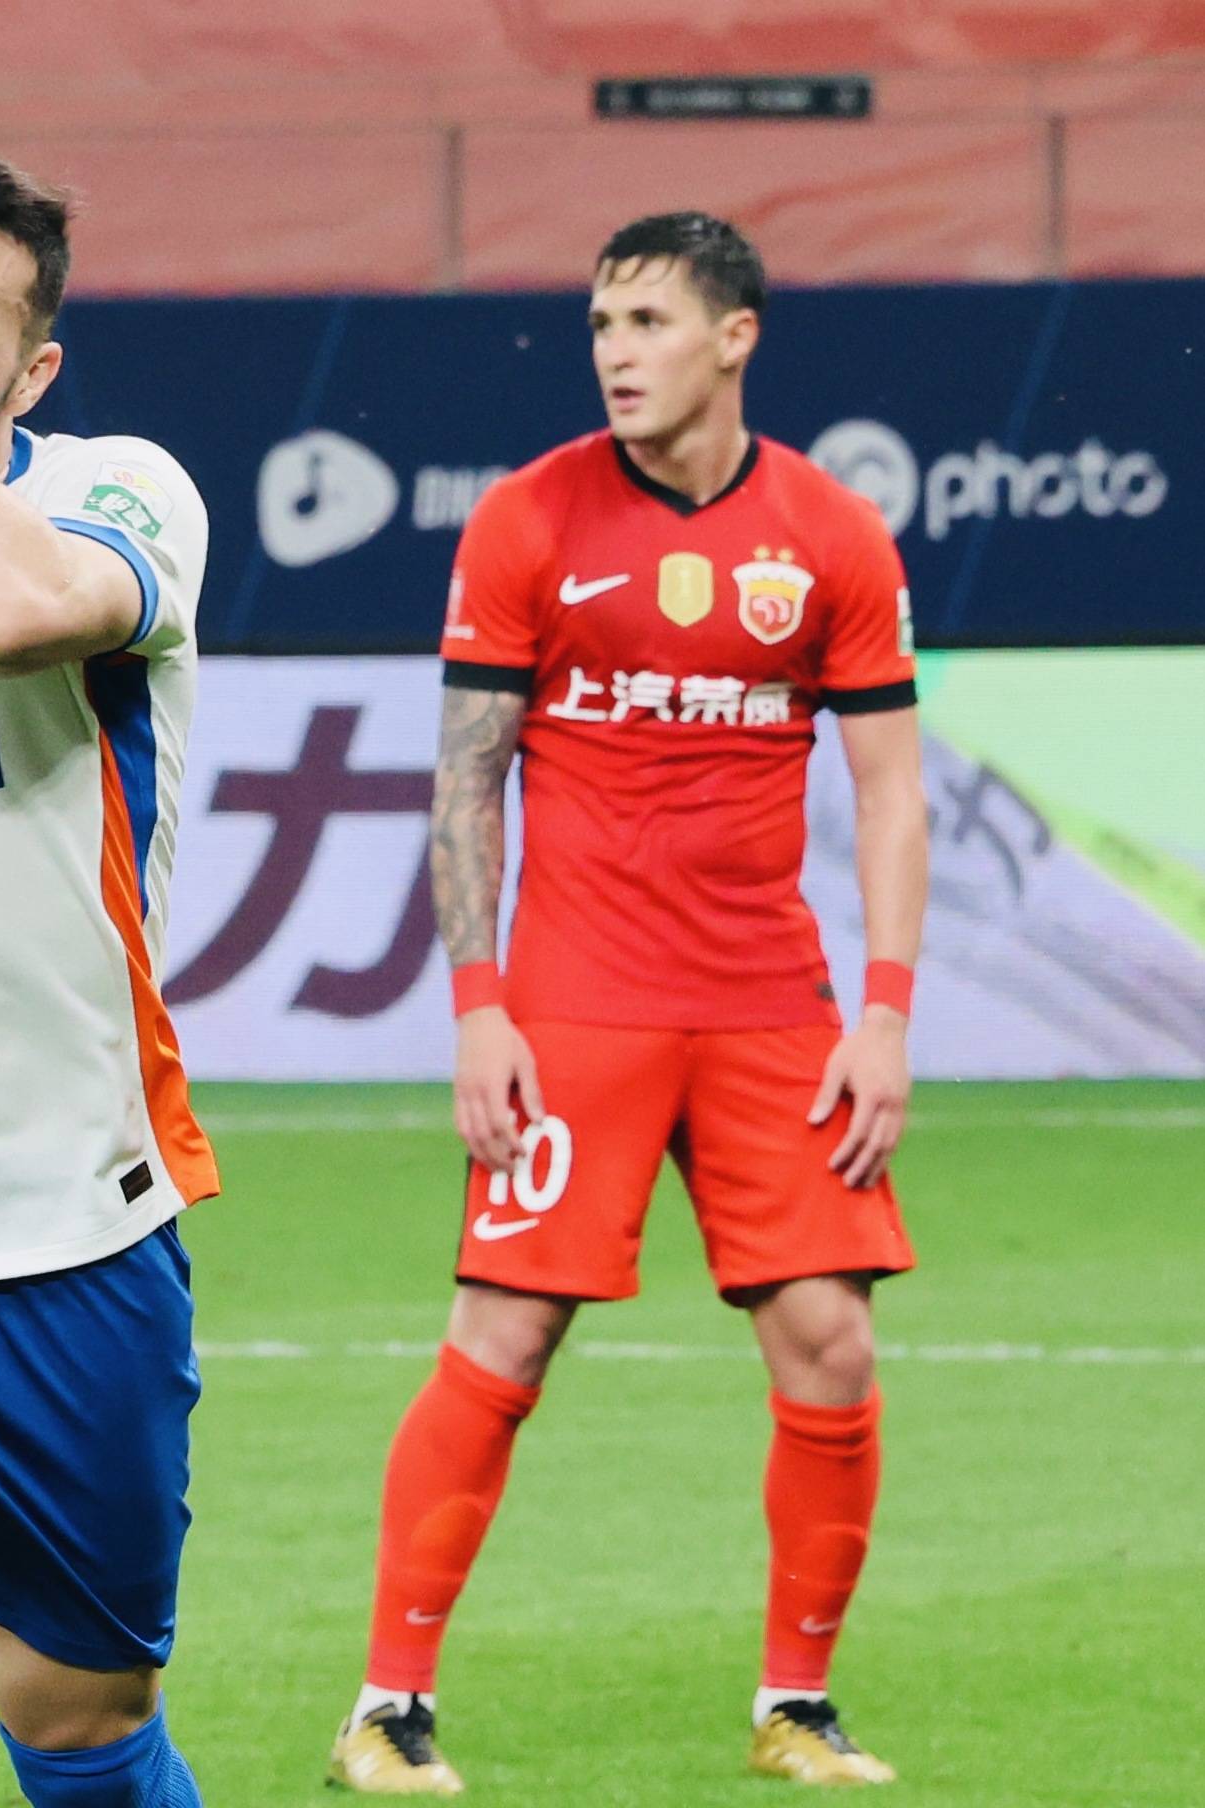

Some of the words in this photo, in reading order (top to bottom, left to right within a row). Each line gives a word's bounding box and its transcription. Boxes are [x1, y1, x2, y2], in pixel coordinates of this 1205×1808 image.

[925, 438, 1168, 541] photo
[546, 667, 794, 726] 上汽荣威
